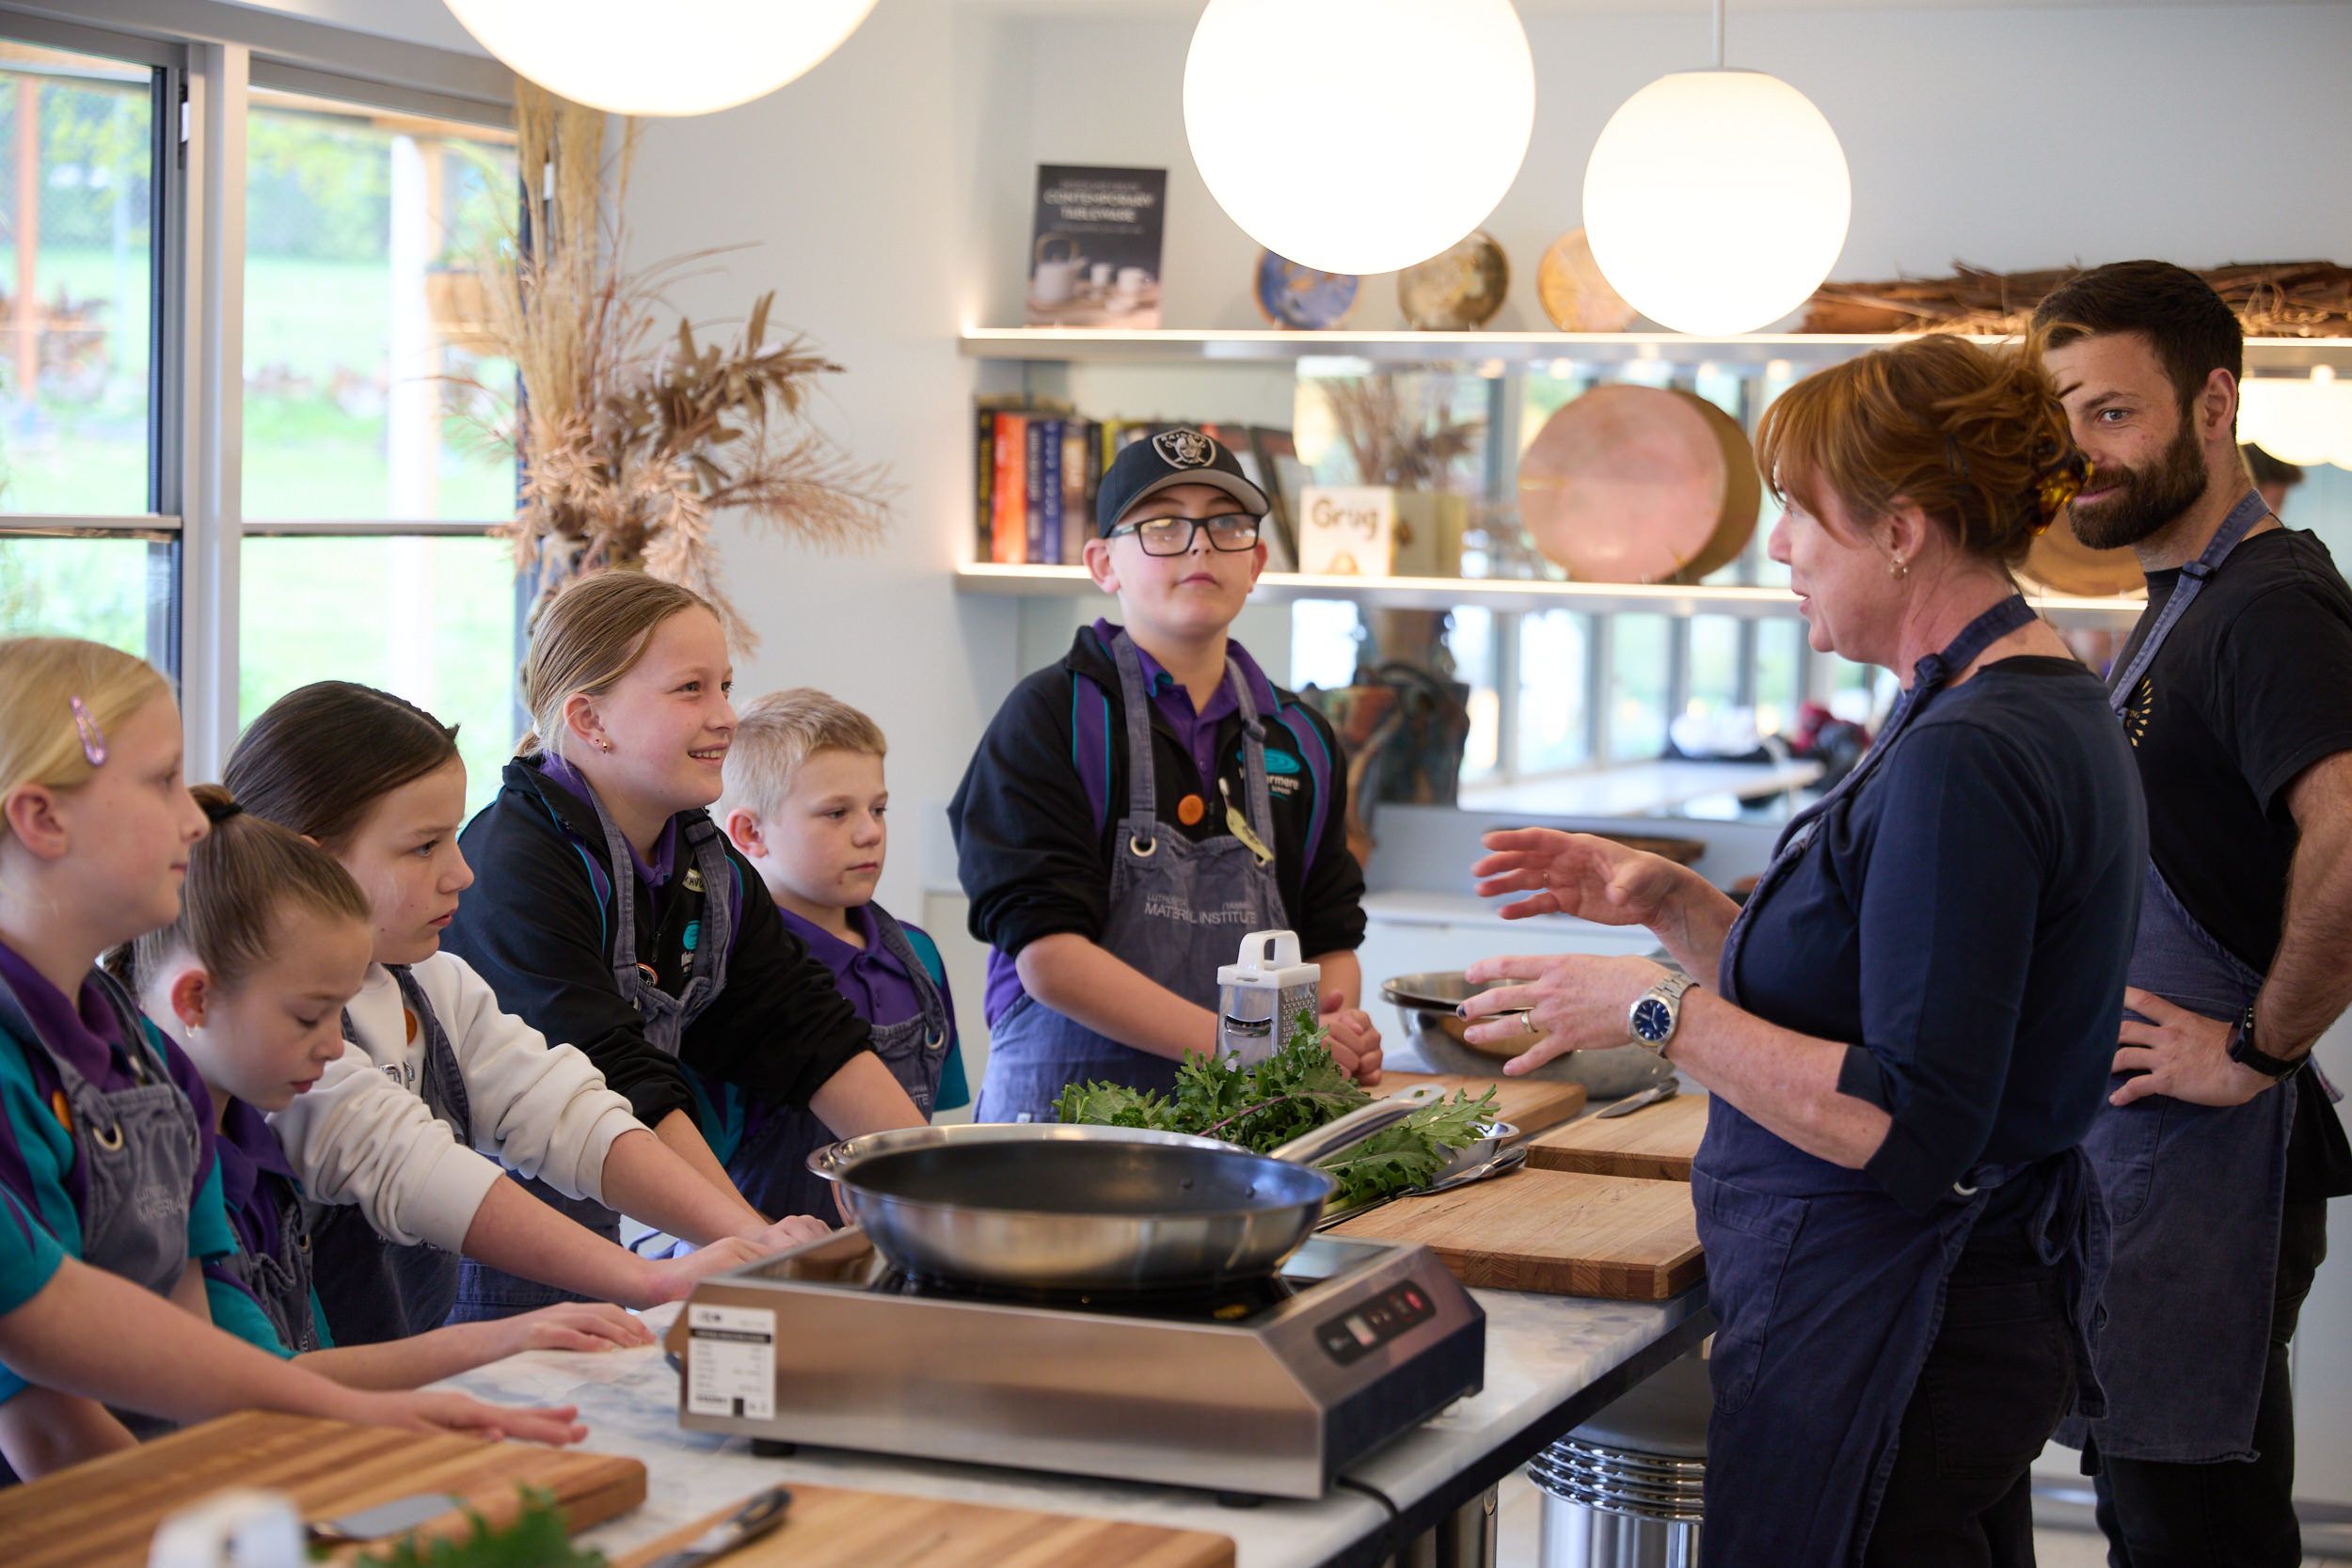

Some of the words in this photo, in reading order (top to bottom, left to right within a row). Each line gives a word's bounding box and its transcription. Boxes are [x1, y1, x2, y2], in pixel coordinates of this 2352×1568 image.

[1043, 189, 1154, 207] CONTEMPORARY
[1060, 207, 1136, 223] TABLEWARE
[1311, 497, 1377, 541] Grug
[1144, 902, 1197, 923] MATERIL
